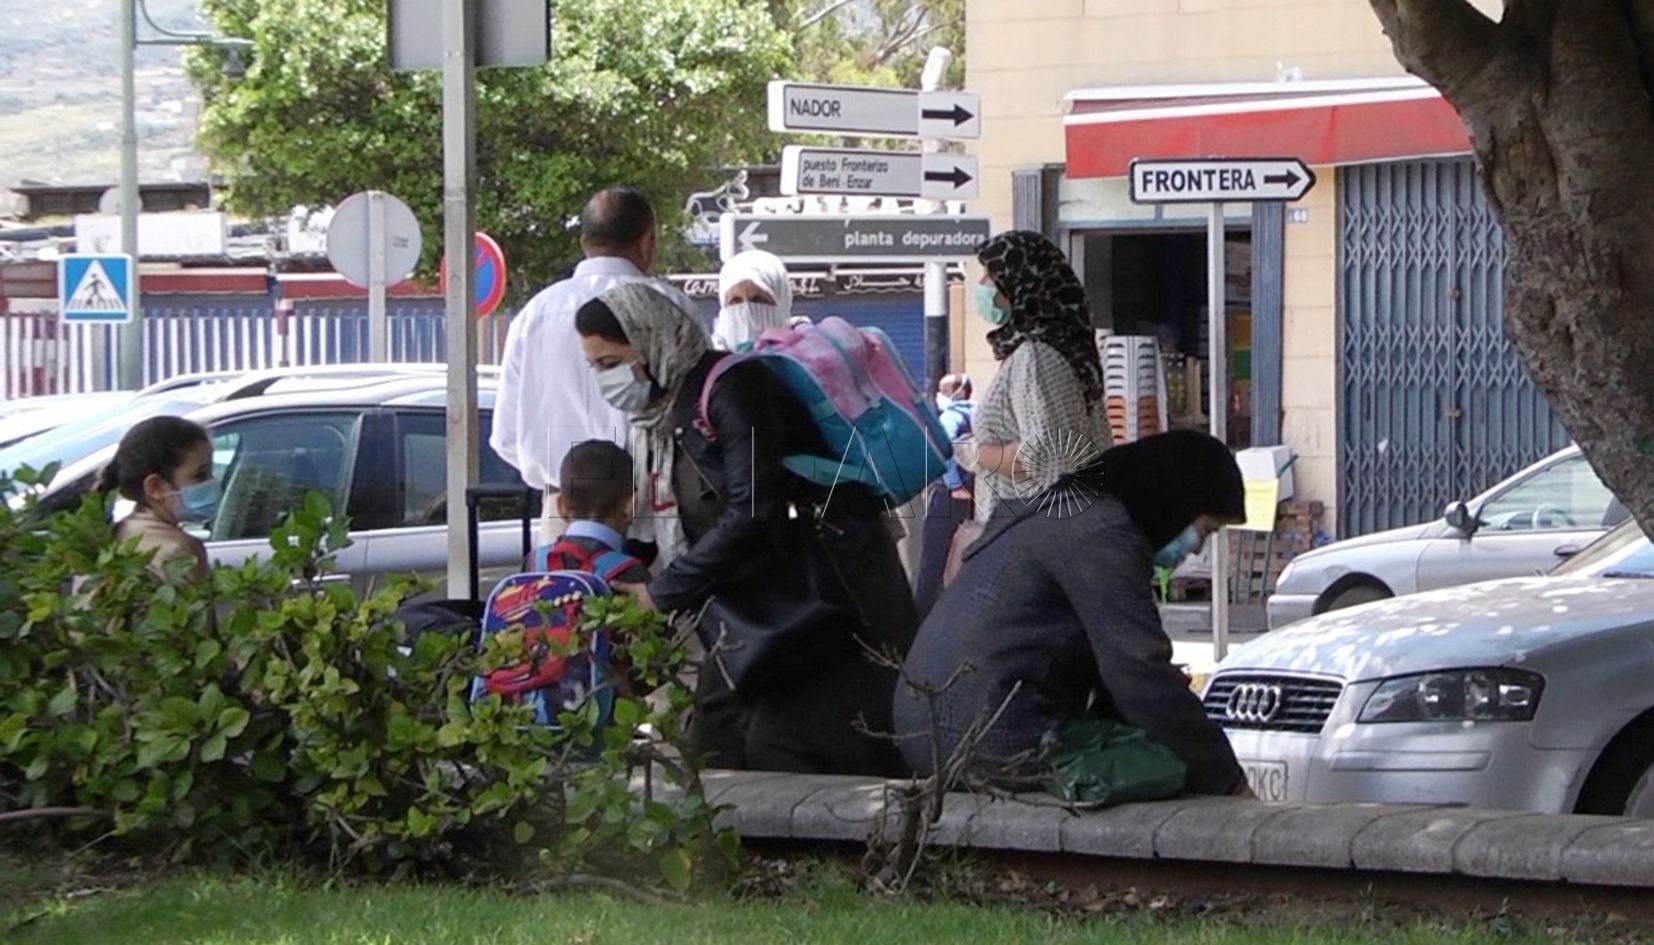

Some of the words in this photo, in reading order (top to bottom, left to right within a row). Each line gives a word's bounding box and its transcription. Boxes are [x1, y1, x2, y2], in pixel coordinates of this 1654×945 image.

[790, 98, 842, 118] NADOR
[802, 158, 837, 174] puesto
[841, 157, 889, 173] Fronterizo
[802, 174, 814, 188] de
[1142, 168, 1257, 193] FRONTERA
[844, 231, 894, 249] planta
[902, 231, 986, 249] depuradora
